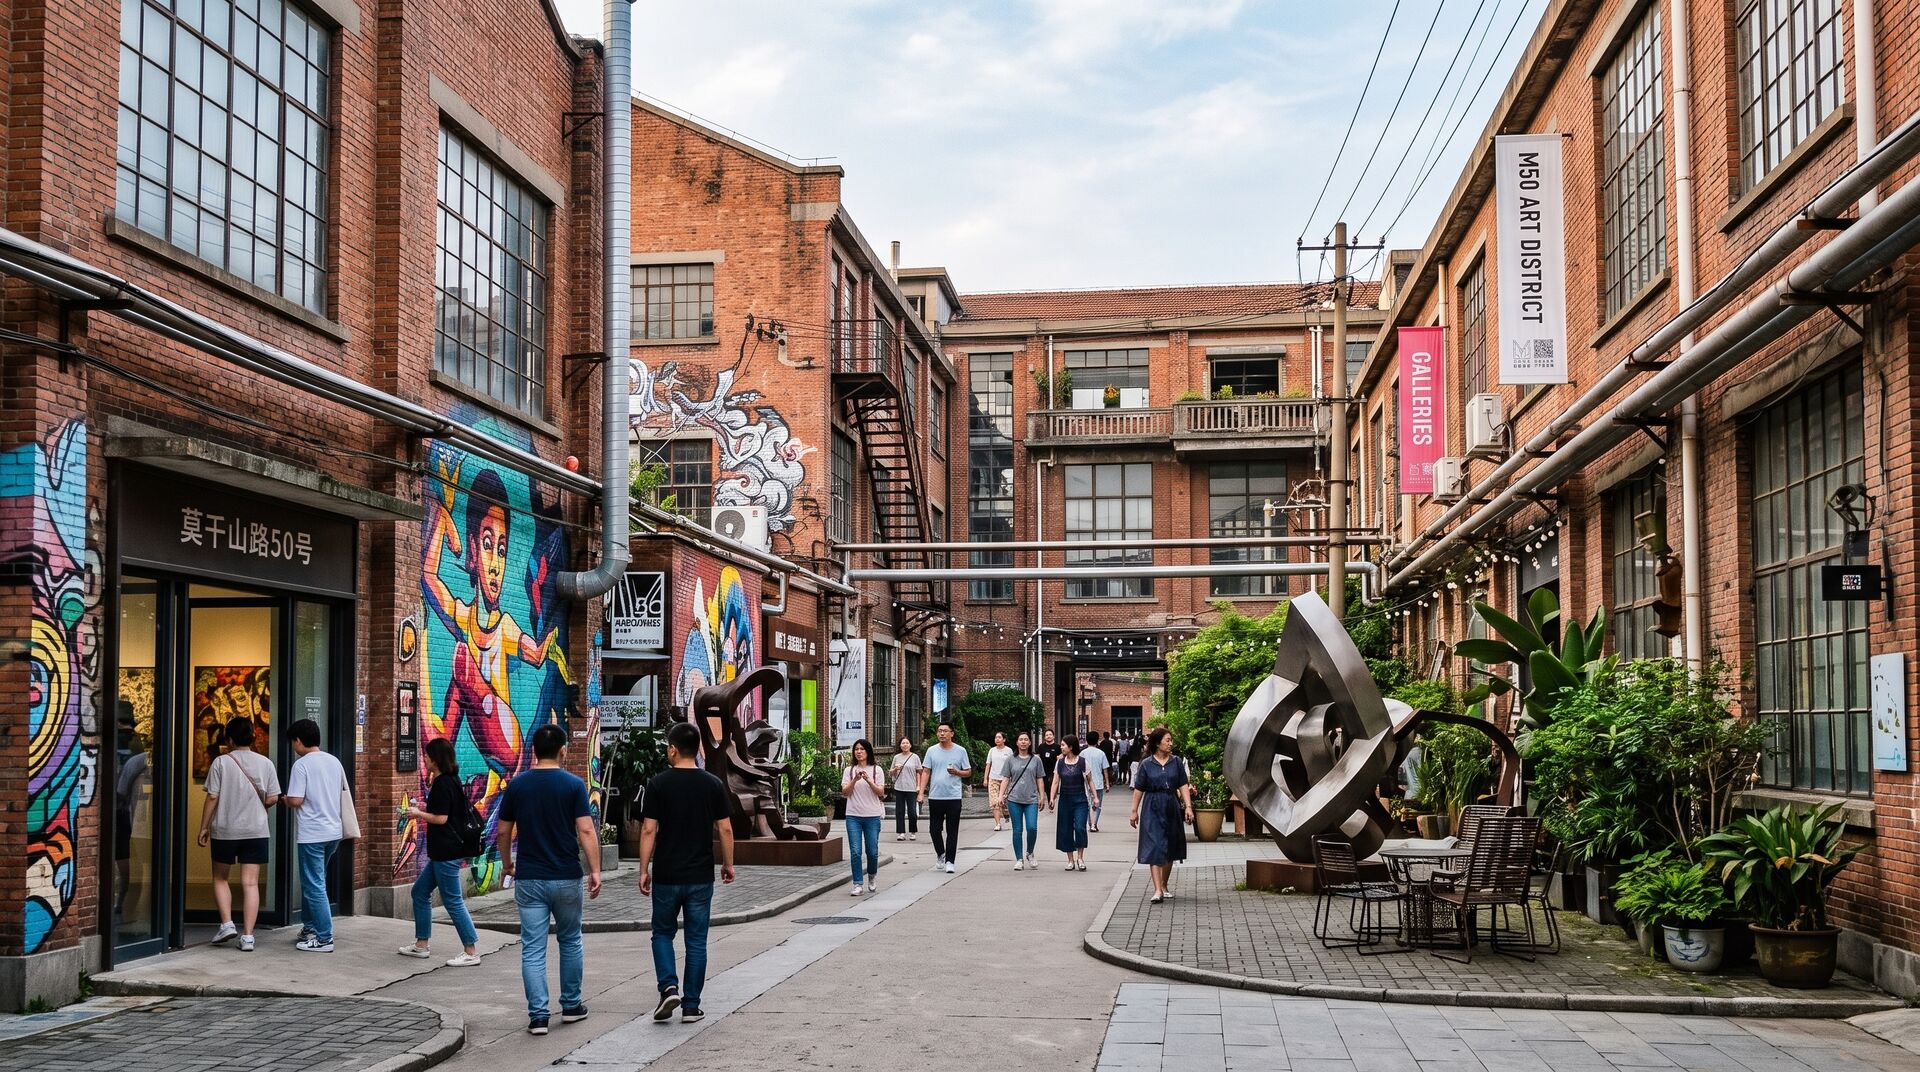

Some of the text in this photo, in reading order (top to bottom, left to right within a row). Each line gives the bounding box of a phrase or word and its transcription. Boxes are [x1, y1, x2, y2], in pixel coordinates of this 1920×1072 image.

[1518, 152, 1543, 324] M50 ART DISTRICT
[1411, 351, 1433, 446] GALLERIES
[180, 506, 313, 565] 莫干山路50号
